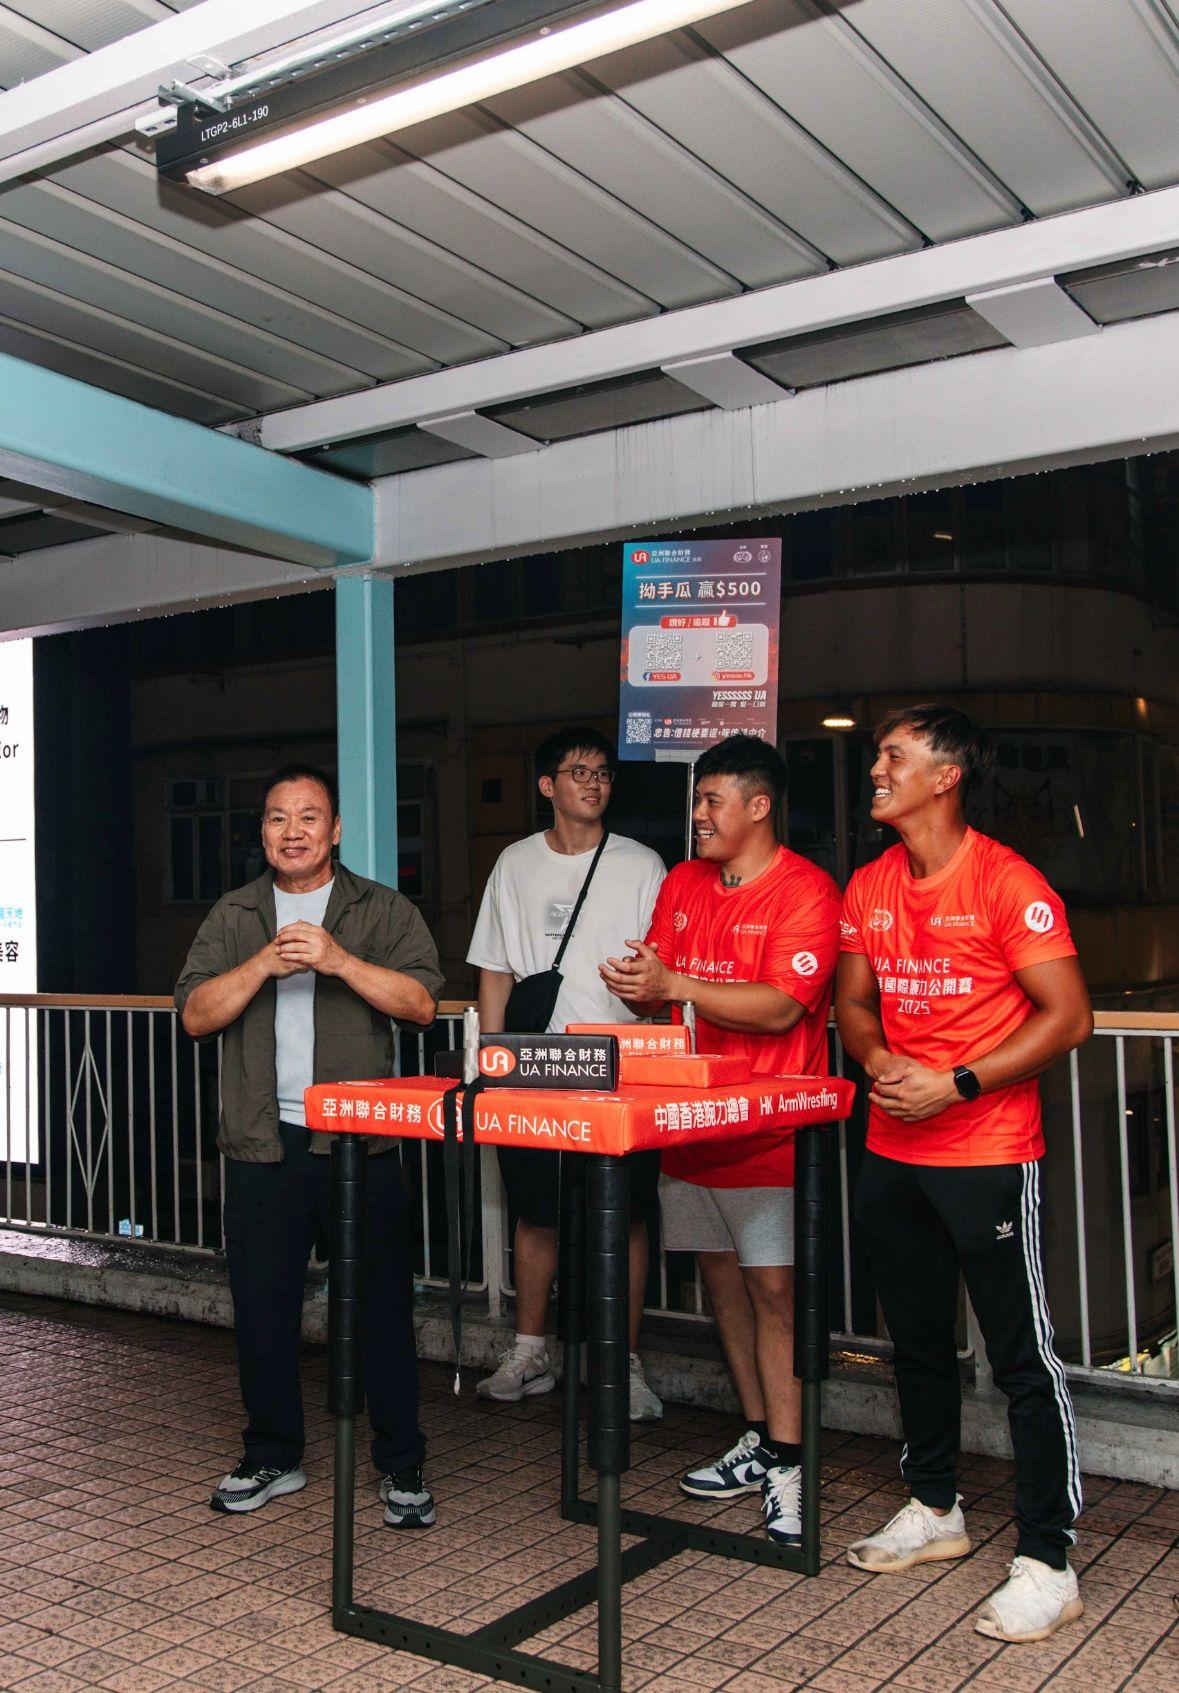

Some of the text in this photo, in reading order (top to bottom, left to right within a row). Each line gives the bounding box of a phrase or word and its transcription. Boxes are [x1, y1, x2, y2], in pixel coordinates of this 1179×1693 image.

[201, 105, 269, 141] LTGP2-6L1-190
[634, 552, 647, 563] UA
[662, 556, 690, 564] FINANCE
[639, 580, 761, 599] 拗手瓜 贏$500
[754, 690, 767, 701] UA
[0, 741, 19, 759] or
[0, 940, 19, 962] 容
[898, 998, 931, 1015] 2025
[482, 1051, 509, 1072] UA
[520, 1048, 608, 1062] 亞洲聯合財務
[520, 1064, 608, 1078] UA FINANCE
[322, 1098, 422, 1125] 亞洲聯合財務
[654, 1096, 749, 1133] 中國香港腕力總會
[759, 1096, 774, 1116] HK
[476, 1112, 591, 1142] UA FINANCE
